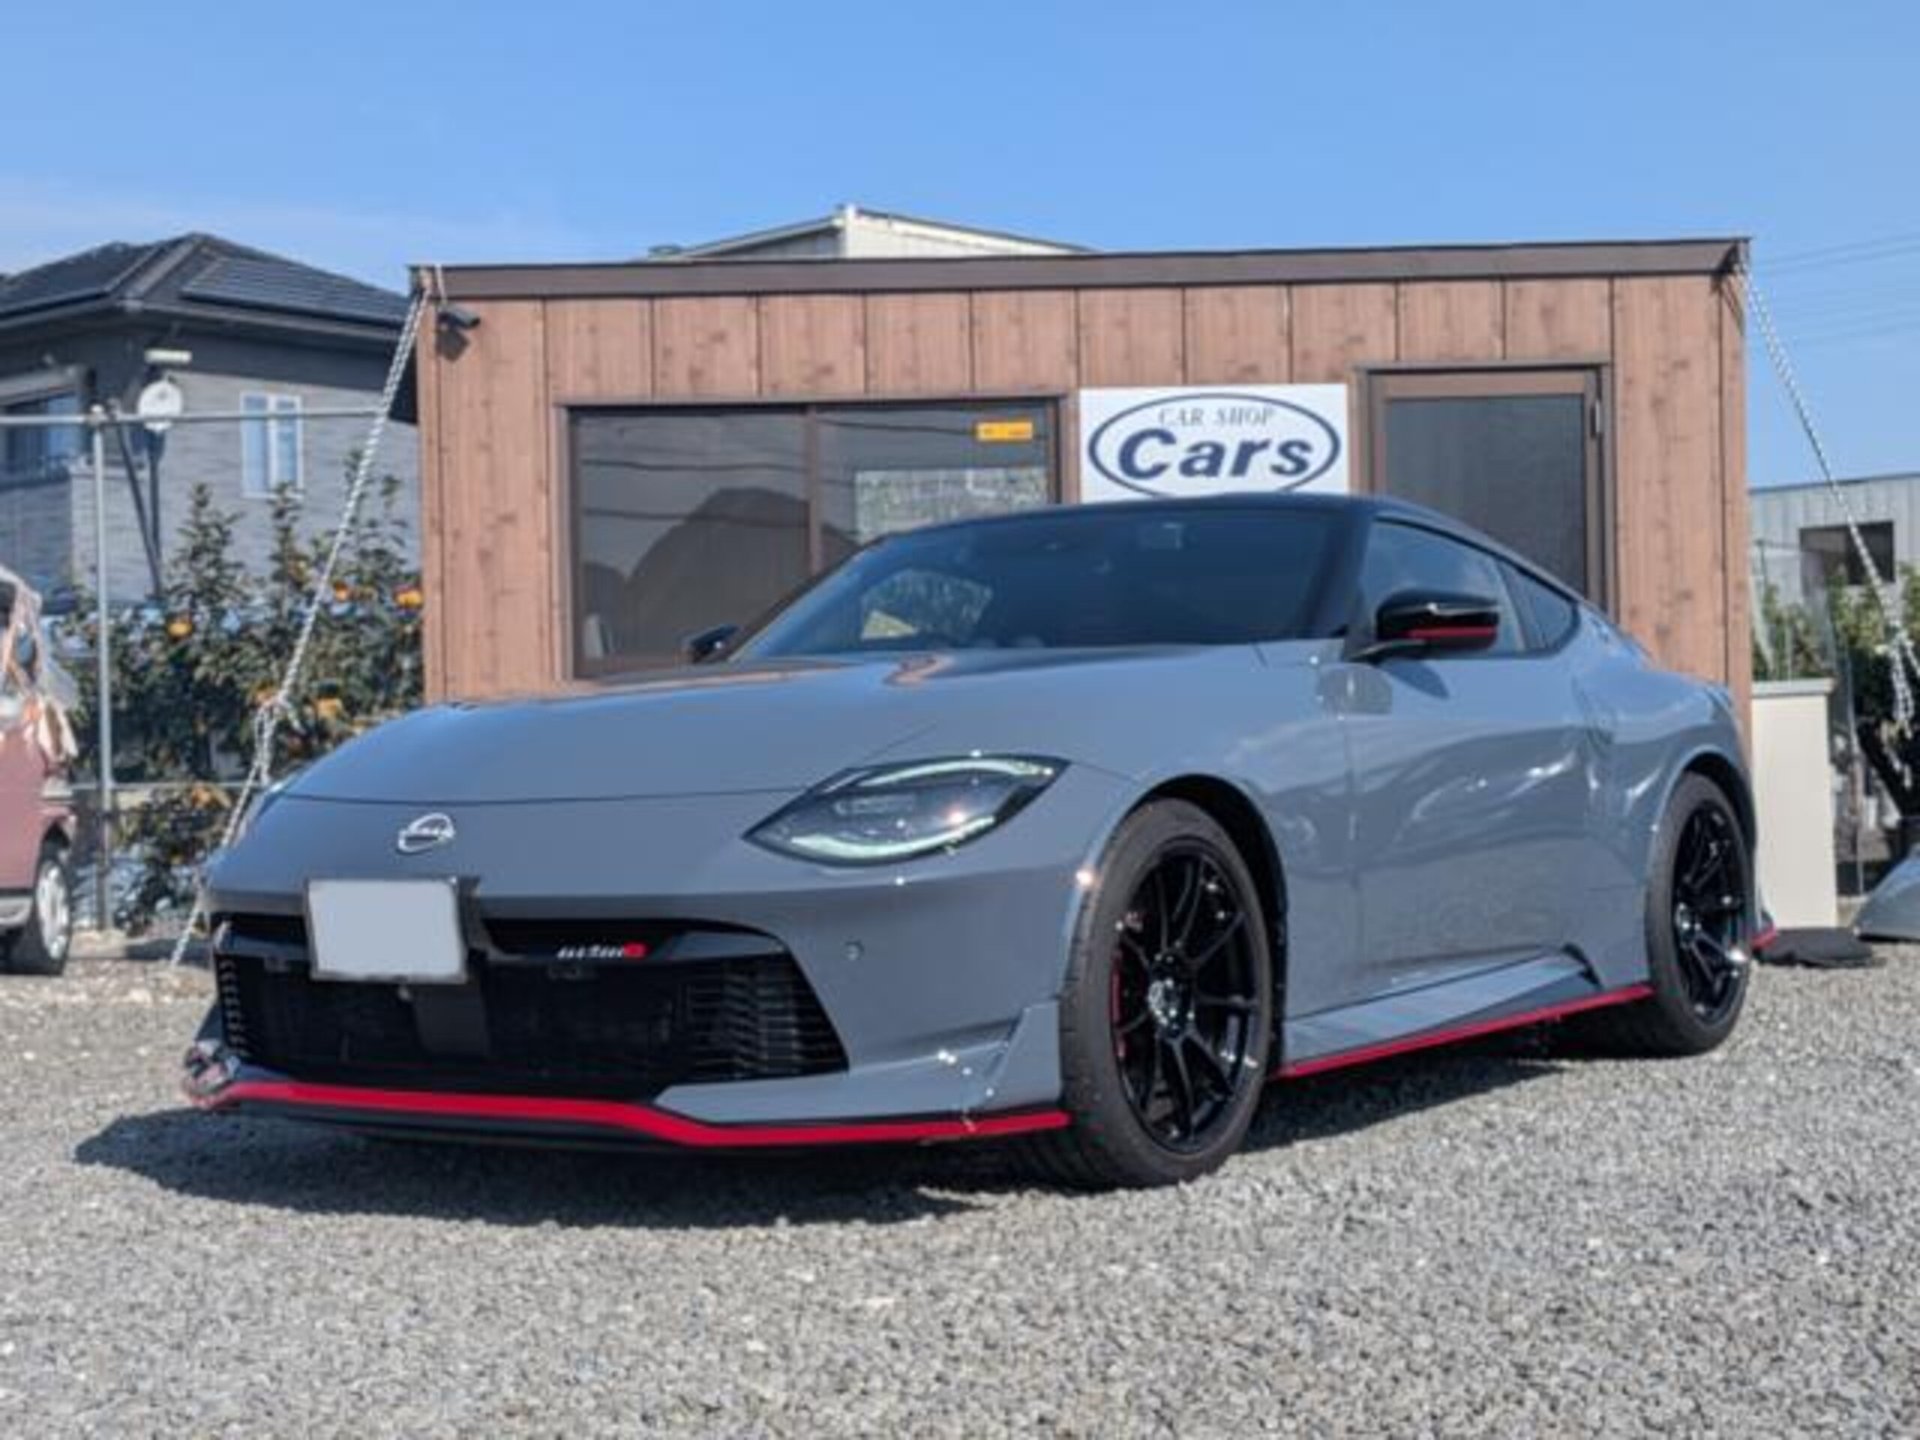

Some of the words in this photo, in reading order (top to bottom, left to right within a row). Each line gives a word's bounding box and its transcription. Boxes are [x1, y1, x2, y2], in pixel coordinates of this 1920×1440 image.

[1158, 407, 1204, 426] CAR
[1214, 405, 1274, 426] SHOP
[1118, 427, 1314, 480] Cars
